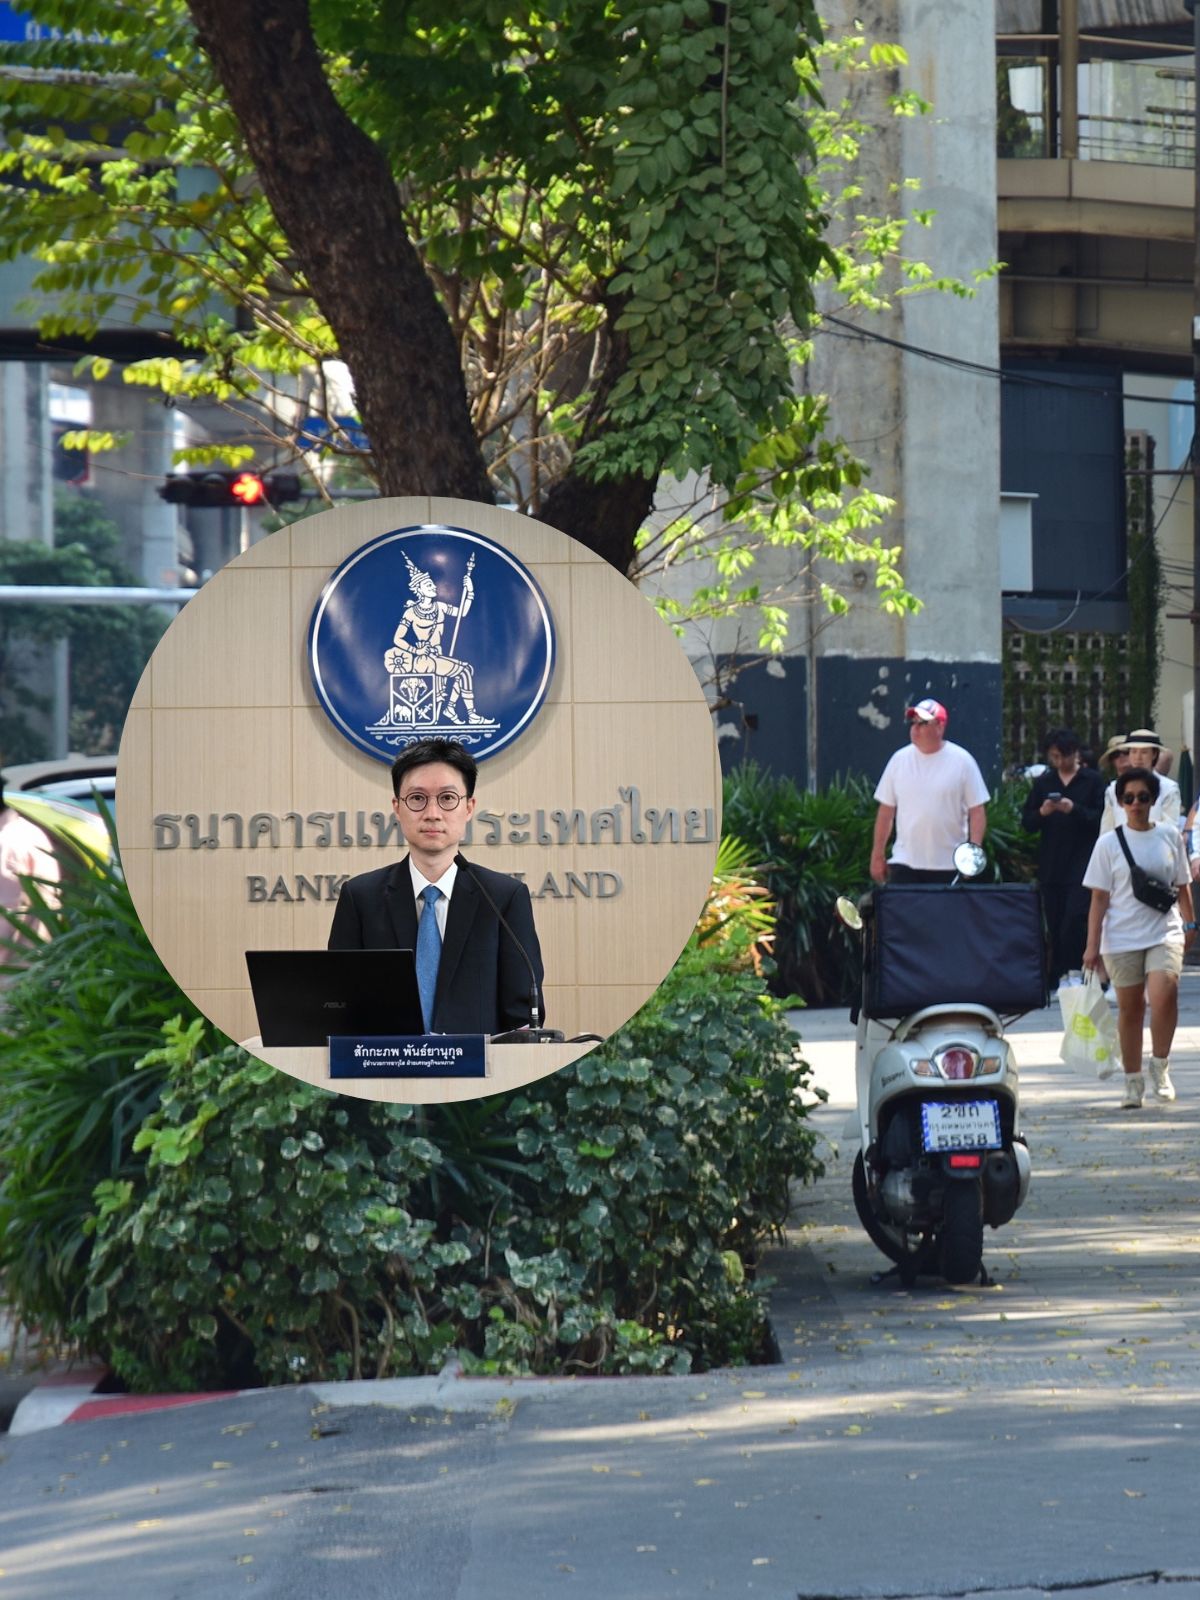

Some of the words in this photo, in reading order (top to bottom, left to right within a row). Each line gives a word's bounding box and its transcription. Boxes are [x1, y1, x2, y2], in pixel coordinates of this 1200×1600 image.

[153, 786, 716, 851] ธนาคารแหระเทศไทย
[246, 874, 350, 903] BANK
[353, 1043, 400, 1057] สักกะภพ
[937, 1133, 988, 1148] 5558
